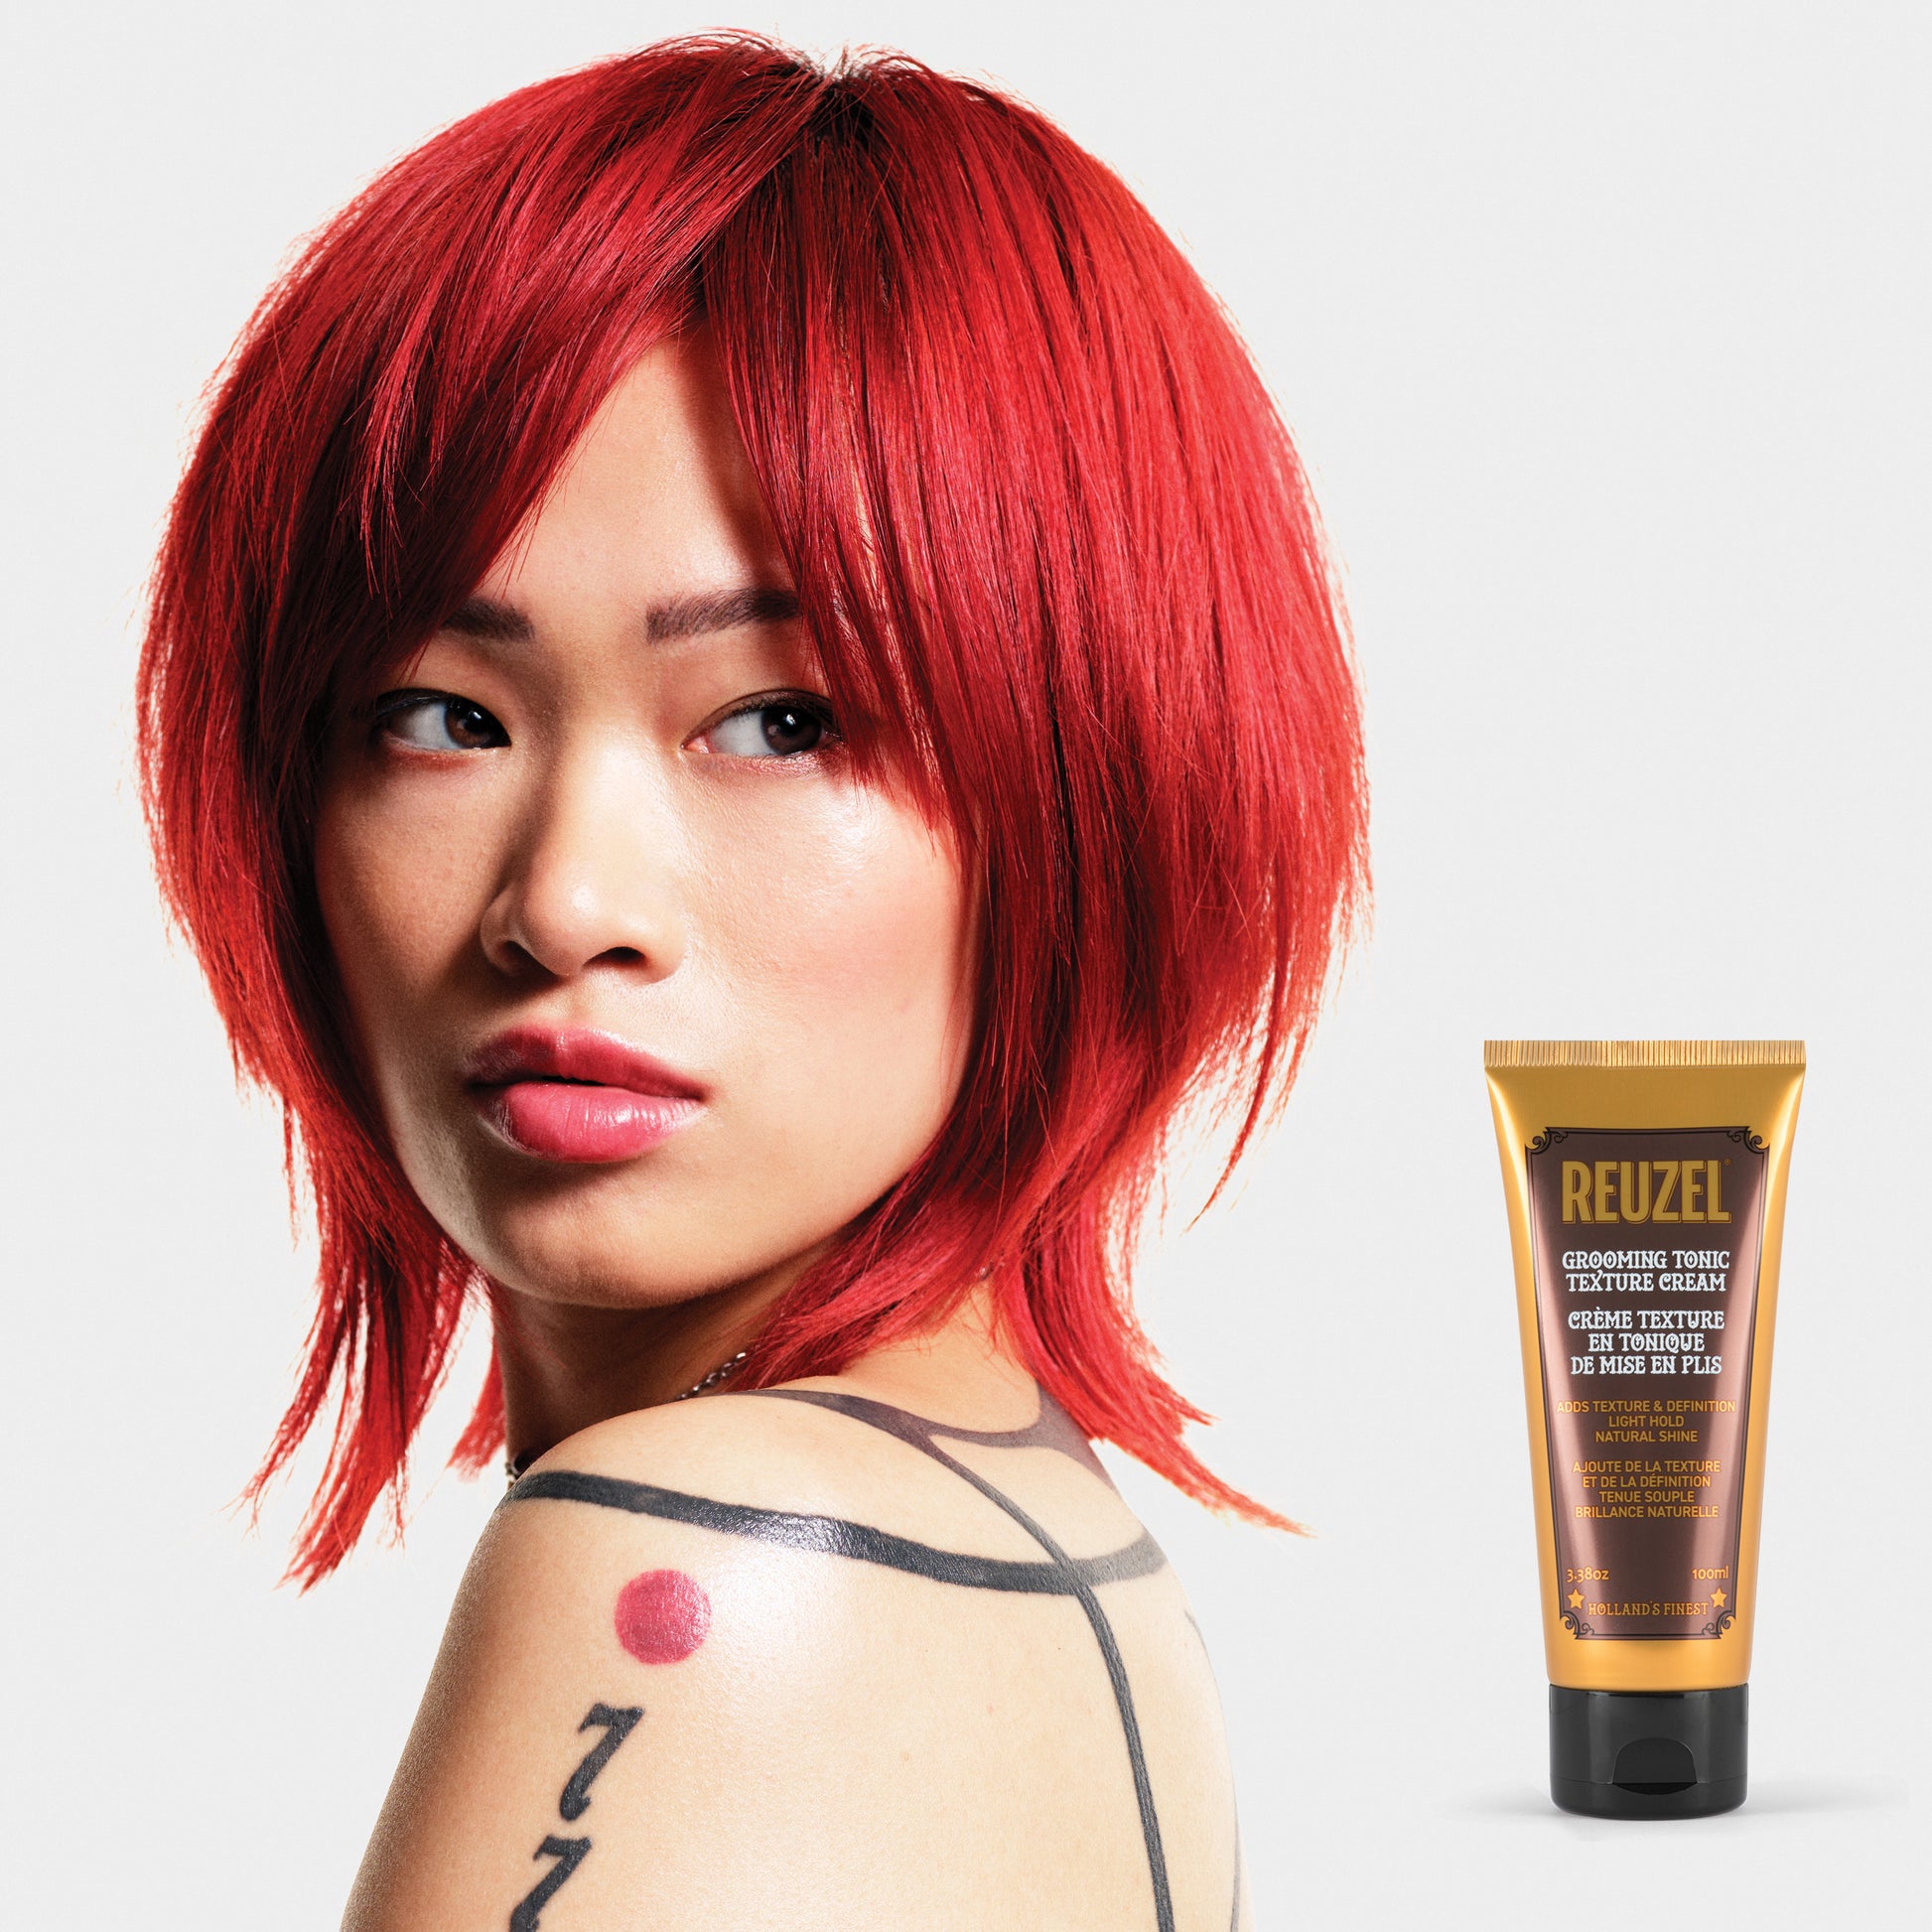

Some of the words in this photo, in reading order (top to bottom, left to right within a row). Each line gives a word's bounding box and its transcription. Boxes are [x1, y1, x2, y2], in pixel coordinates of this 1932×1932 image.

[1562, 1250, 1667, 1270] GROOMING
[1672, 1250, 1730, 1269] TONIC
[1566, 1270, 1654, 1292] TEXTURE
[1659, 1273, 1726, 1292] CREAM
[1568, 1307, 1632, 1329] CRÈME
[1637, 1311, 1725, 1329] TEXTURE
[1588, 1333, 1614, 1351] EN
[1618, 1333, 1705, 1353] TONIQUE
[1571, 1356, 1594, 1375] DE
[1599, 1356, 1646, 1375] MISE
[1650, 1356, 1677, 1374] EN
[1682, 1356, 1723, 1374] PLIS
[1557, 1401, 1589, 1413] ADDS
[1592, 1401, 1650, 1412] TEXTURE
[1653, 1401, 1663, 1412] &
[1667, 1401, 1735, 1412] DEFINITION
[1608, 1416, 1646, 1427] LIGHT
[1650, 1416, 1684, 1427] HOLD
[1595, 1431, 1656, 1442] NATURAL
[1659, 1431, 1699, 1442] SHINE
[1573, 1461, 1622, 1473] AJOUTE
[1625, 1461, 1642, 1472] DE
[1645, 1461, 1662, 1472] LA
[1665, 1460, 1721, 1472] TEXTURE
[1583, 1476, 1597, 1488] ET
[1600, 1476, 1617, 1487] DE
[1620, 1476, 1637, 1487] LA
[1640, 1473, 1711, 1487] DÉFINITION
[1599, 1491, 1641, 1502] TENUE
[1644, 1491, 1695, 1502] SOUPLE
[1576, 1506, 1644, 1518] BRILLANCE
[1647, 1506, 1719, 1518] NATURELLE
[1567, 1568, 1609, 1583] 3.38oz
[1692, 1566, 1729, 1580] 100ml
[1588, 1600, 1660, 1615] HOLLAND'S
[1663, 1602, 1709, 1614] FINEST
